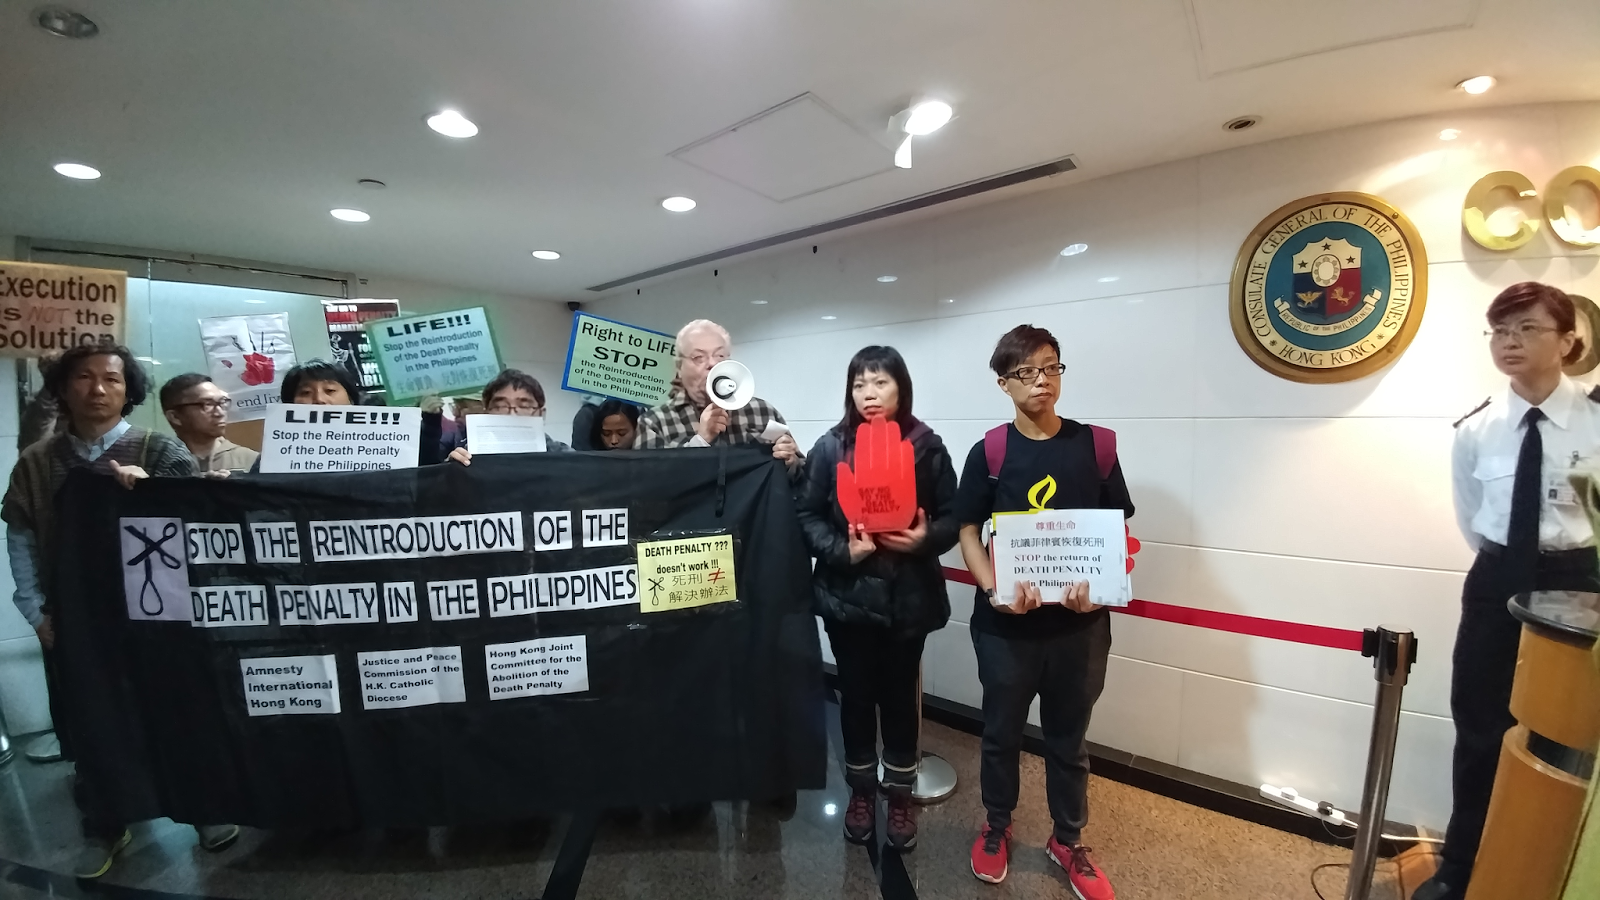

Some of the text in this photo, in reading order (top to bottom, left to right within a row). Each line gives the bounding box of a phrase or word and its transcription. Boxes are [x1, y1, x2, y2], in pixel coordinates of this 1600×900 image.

[1248, 206, 1410, 338] CONSULATE GENERAL OF THE PHILIPPINES
[0, 304, 115, 326] s NOT the
[1282, 312, 1311, 332] REPUBLIC
[1333, 306, 1373, 332] PHILIPPINES
[387, 314, 471, 337] LIFE!!!
[383, 330, 483, 352] Stop the Reintroduction
[581, 321, 624, 343] Right
[628, 334, 643, 347] to
[393, 342, 480, 362] of the Death Penalty
[592, 346, 658, 370] STOP
[1279, 339, 1377, 366] HONG KONG
[405, 354, 477, 372] in the Philippines
[581, 359, 665, 385] the Reintroduction
[574, 367, 667, 395] of the Death Penalty
[593, 380, 608, 389] the
[610, 384, 660, 401] Philippines
[236, 393, 281, 408] end liv
[285, 410, 400, 425] LIFE!!!
[272, 429, 410, 442] Stop the Reintroduction
[280, 445, 400, 457] of the Death Penalty
[289, 460, 392, 472] in the Philippines
[1035, 520, 1076, 531] 尊重生命
[188, 512, 626, 559] STOP THE REINTRODUCTION OF THE
[1010, 537, 1105, 548] 抗議菲律賓恢復死刑
[645, 540, 729, 557] DEATH PENALTY ???
[1014, 554, 1102, 562] STOP the return of
[656, 559, 719, 574] doesn't work !!!
[1014, 566, 1103, 575] DEATH PENALTY
[671, 573, 703, 587] 死刑
[190, 569, 637, 622] DEATH PENALTY IN THE PHILIPPINES
[669, 585, 729, 603] 解決辦法
[489, 643, 574, 659] Hong Kong Joint
[362, 653, 457, 667] Justice and Peace
[490, 655, 582, 671] Committee for the
[245, 665, 304, 677] Amnesty
[363, 664, 460, 678] Commission of the
[492, 668, 570, 682] Abolition of the
[248, 680, 333, 693] International
[365, 678, 434, 691] H.K. Catholic
[493, 681, 563, 693] Death Penalty
[250, 697, 322, 709] Hong Kong
[367, 693, 408, 703] Diocese
